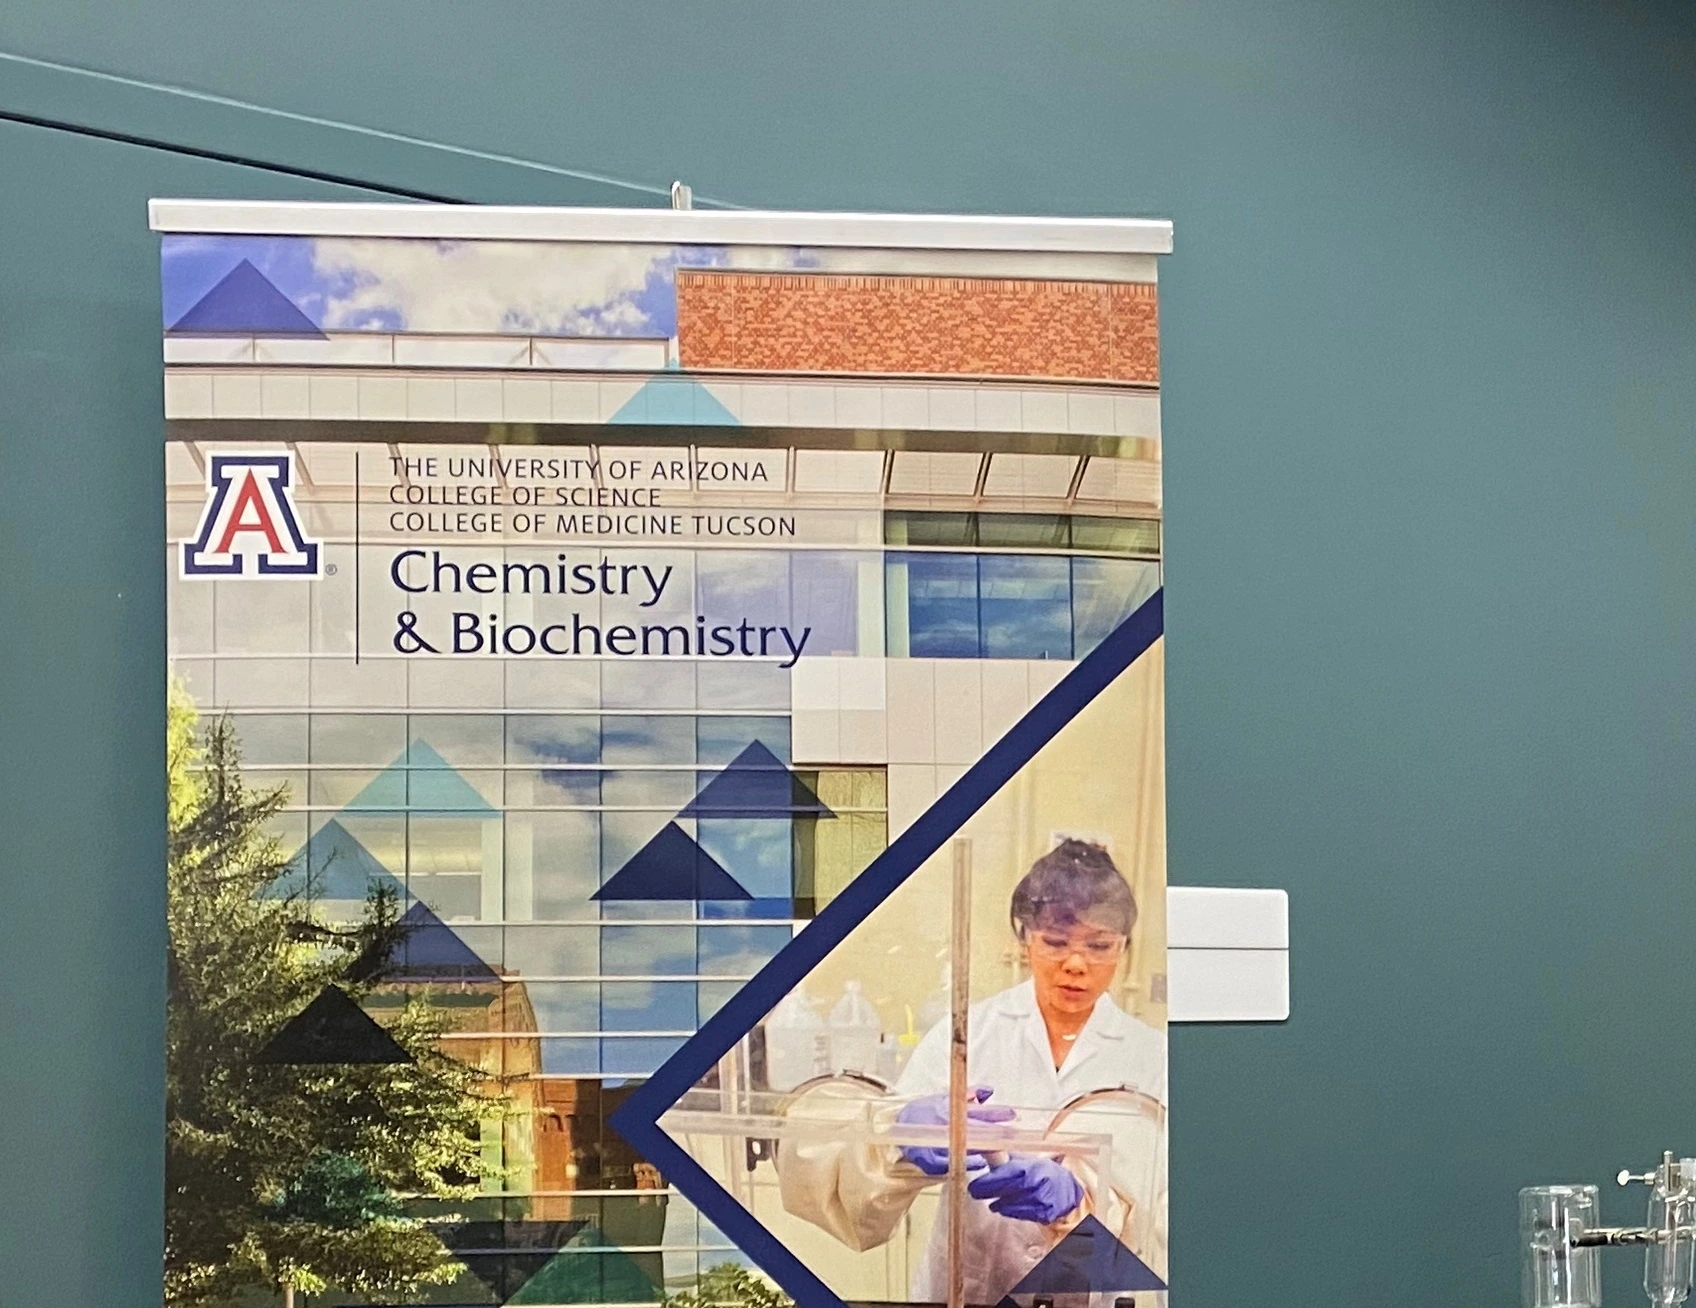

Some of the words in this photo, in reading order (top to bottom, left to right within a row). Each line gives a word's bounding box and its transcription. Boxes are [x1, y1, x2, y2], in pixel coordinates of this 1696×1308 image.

[389, 457, 438, 478] THE
[449, 458, 600, 480] UNIVERSITY
[609, 460, 642, 480] OF
[651, 461, 768, 482] ARIZONA
[179, 450, 323, 581] A
[389, 484, 502, 506] COLLEGE
[512, 486, 546, 506] OF
[556, 487, 662, 507] SCIENCE
[389, 511, 502, 533] COLLEGE
[512, 513, 546, 534] OF
[556, 514, 683, 535] MEDICINE
[691, 516, 796, 536] TUCSON
[390, 550, 672, 606] Chemistry
[392, 611, 444, 656] &
[452, 612, 811, 668] Biochemistry
